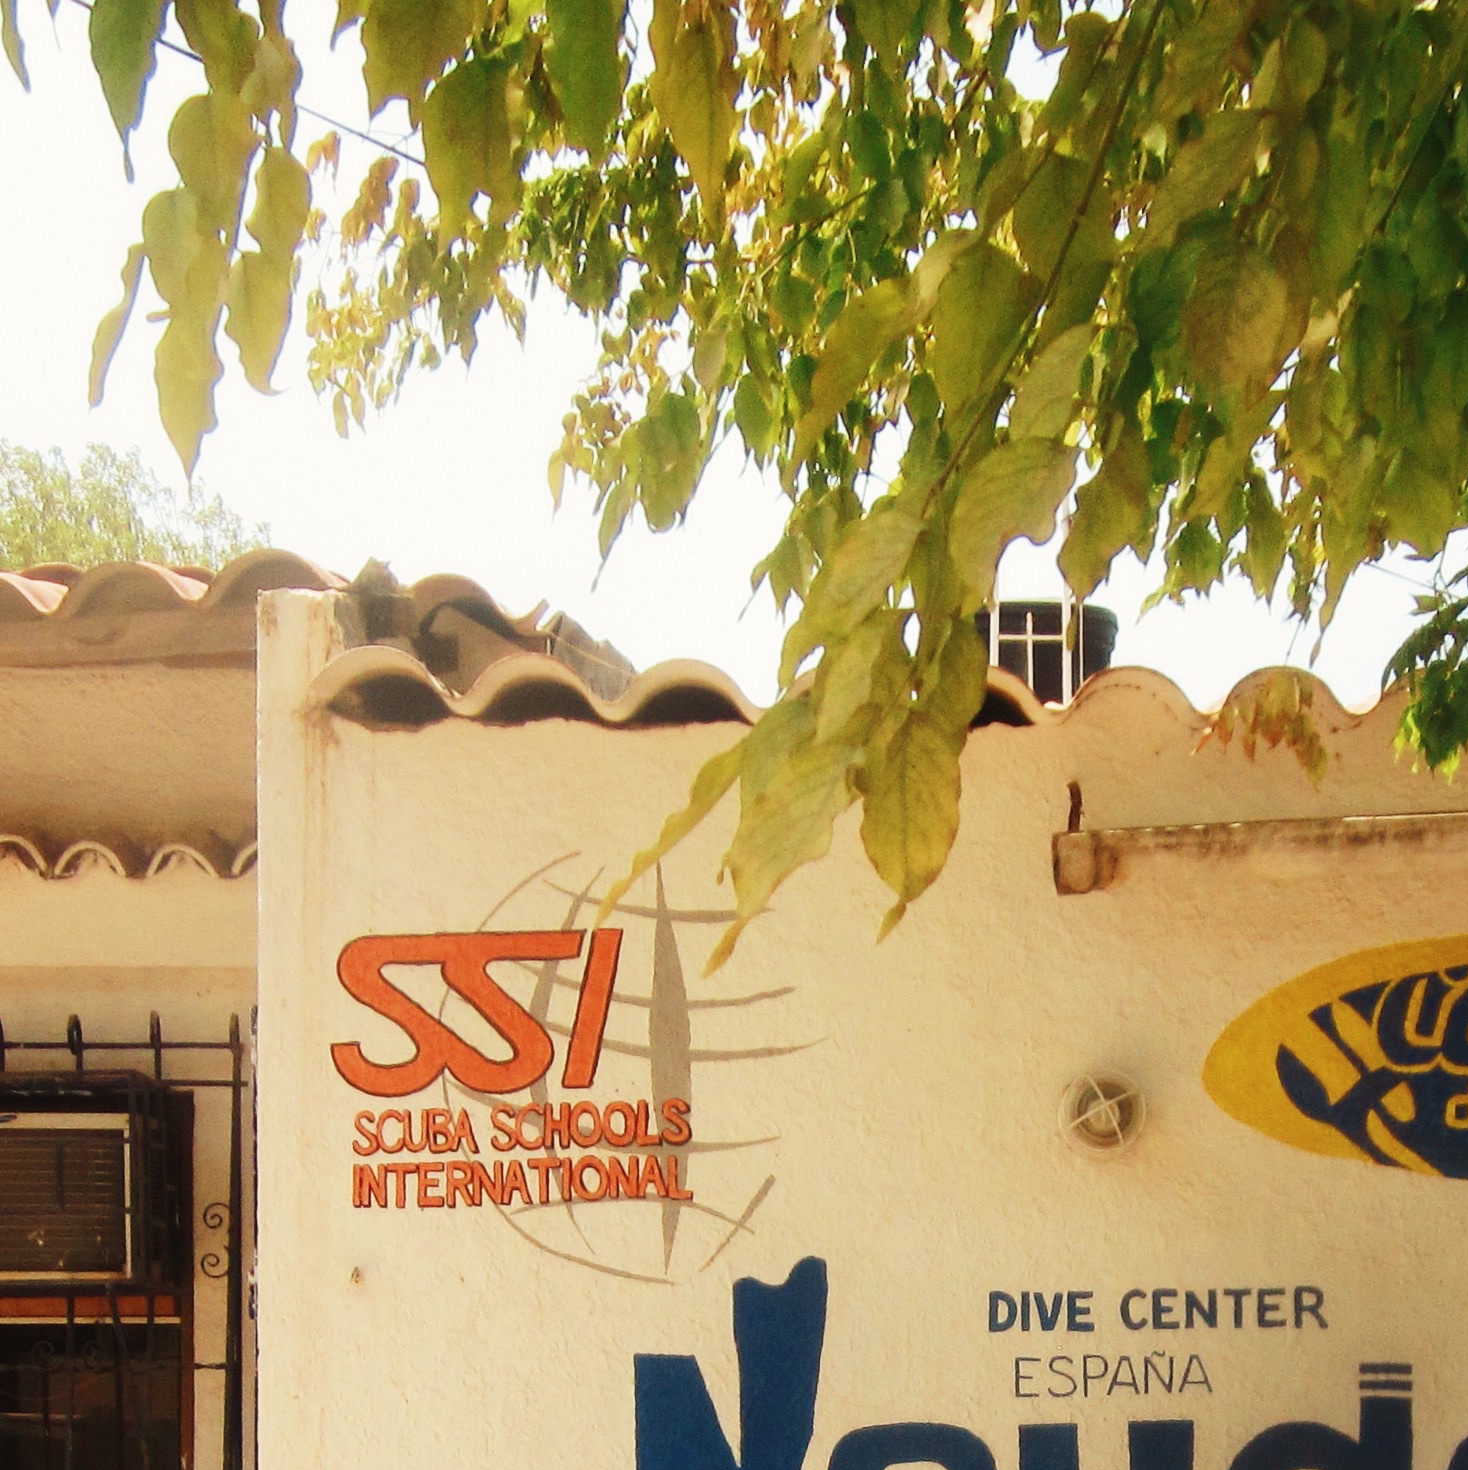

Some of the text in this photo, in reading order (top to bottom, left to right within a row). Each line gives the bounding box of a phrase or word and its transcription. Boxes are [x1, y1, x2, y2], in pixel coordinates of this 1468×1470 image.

[331, 928, 623, 1097] SSI
[352, 1098, 692, 1155] SCUBA SCHOOLS
[352, 1155, 694, 1208] INTERNATIONAL
[988, 1286, 1329, 1332] DIVE CENTER
[1014, 1351, 1213, 1398] ESPAÑA
